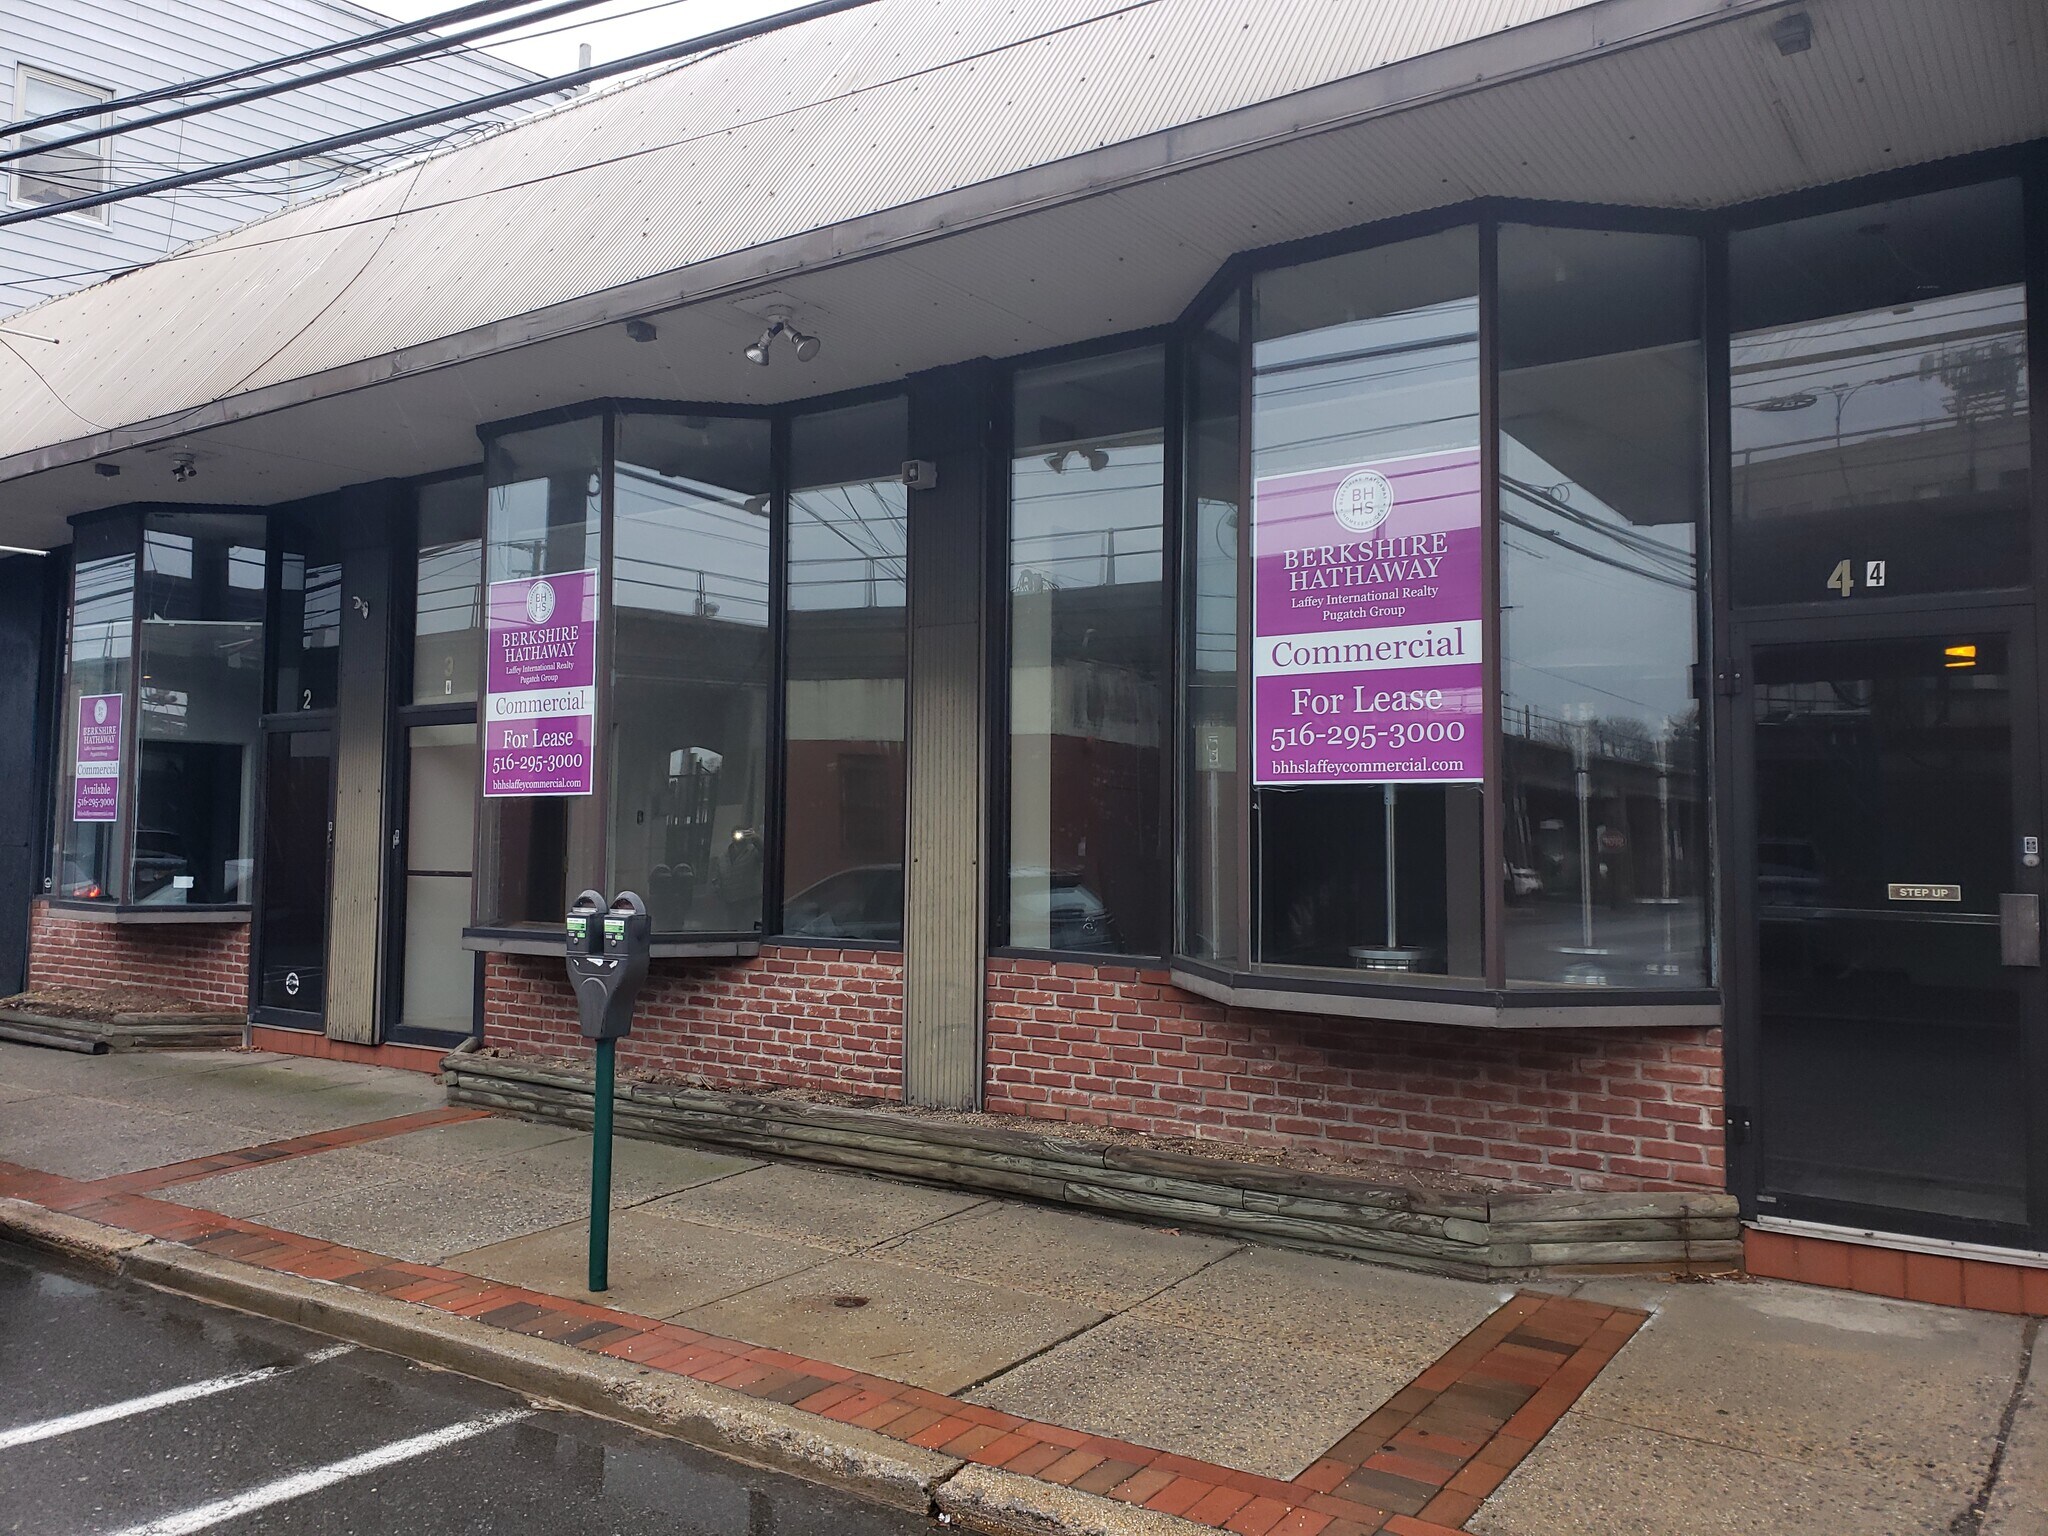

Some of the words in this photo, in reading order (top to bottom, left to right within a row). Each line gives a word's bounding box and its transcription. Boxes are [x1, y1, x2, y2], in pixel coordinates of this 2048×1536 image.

[1353, 487, 1374, 502] BH
[1353, 501, 1374, 516] HS
[1284, 532, 1448, 570] BERKSHIRE
[1289, 557, 1443, 592] HATHAWAY
[1827, 559, 1854, 597] 4
[1869, 562, 1883, 585] 4
[535, 592, 547, 602] BH
[1291, 596, 1324, 609] Laffey
[1326, 588, 1399, 606] International
[1402, 585, 1439, 600] Realty
[1322, 607, 1367, 622] Pugatch
[1369, 605, 1406, 620] Group
[502, 625, 579, 648] BERKSHIRE
[504, 642, 577, 663] HATHAWAY
[1271, 627, 1465, 667] Commercial
[505, 665, 522, 676] Laffey
[522, 662, 556, 674] International
[556, 660, 575, 672] Realty
[541, 673, 559, 684] Group
[303, 689, 312, 710] 2
[495, 690, 585, 716] Commercial
[1291, 688, 1345, 716] For
[1353, 685, 1443, 714] Lease
[83, 725, 117, 736] BERKSHIRE
[83, 735, 116, 745] HATHAWAY
[502, 729, 529, 749] For
[533, 728, 573, 748] Lease
[1270, 722, 1465, 752] 516-295-3000
[77, 763, 118, 776] Commercial
[492, 753, 583, 774] 516-295-3000
[1272, 756, 1464, 776] bhhslaffeycommercial.com
[82, 783, 111, 795] Available
[492, 777, 581, 792] bhhslaffeycommercial.com
[77, 797, 115, 808] 516-295-3000
[1899, 888, 1930, 897] STEP
[1932, 888, 1949, 897] UP
